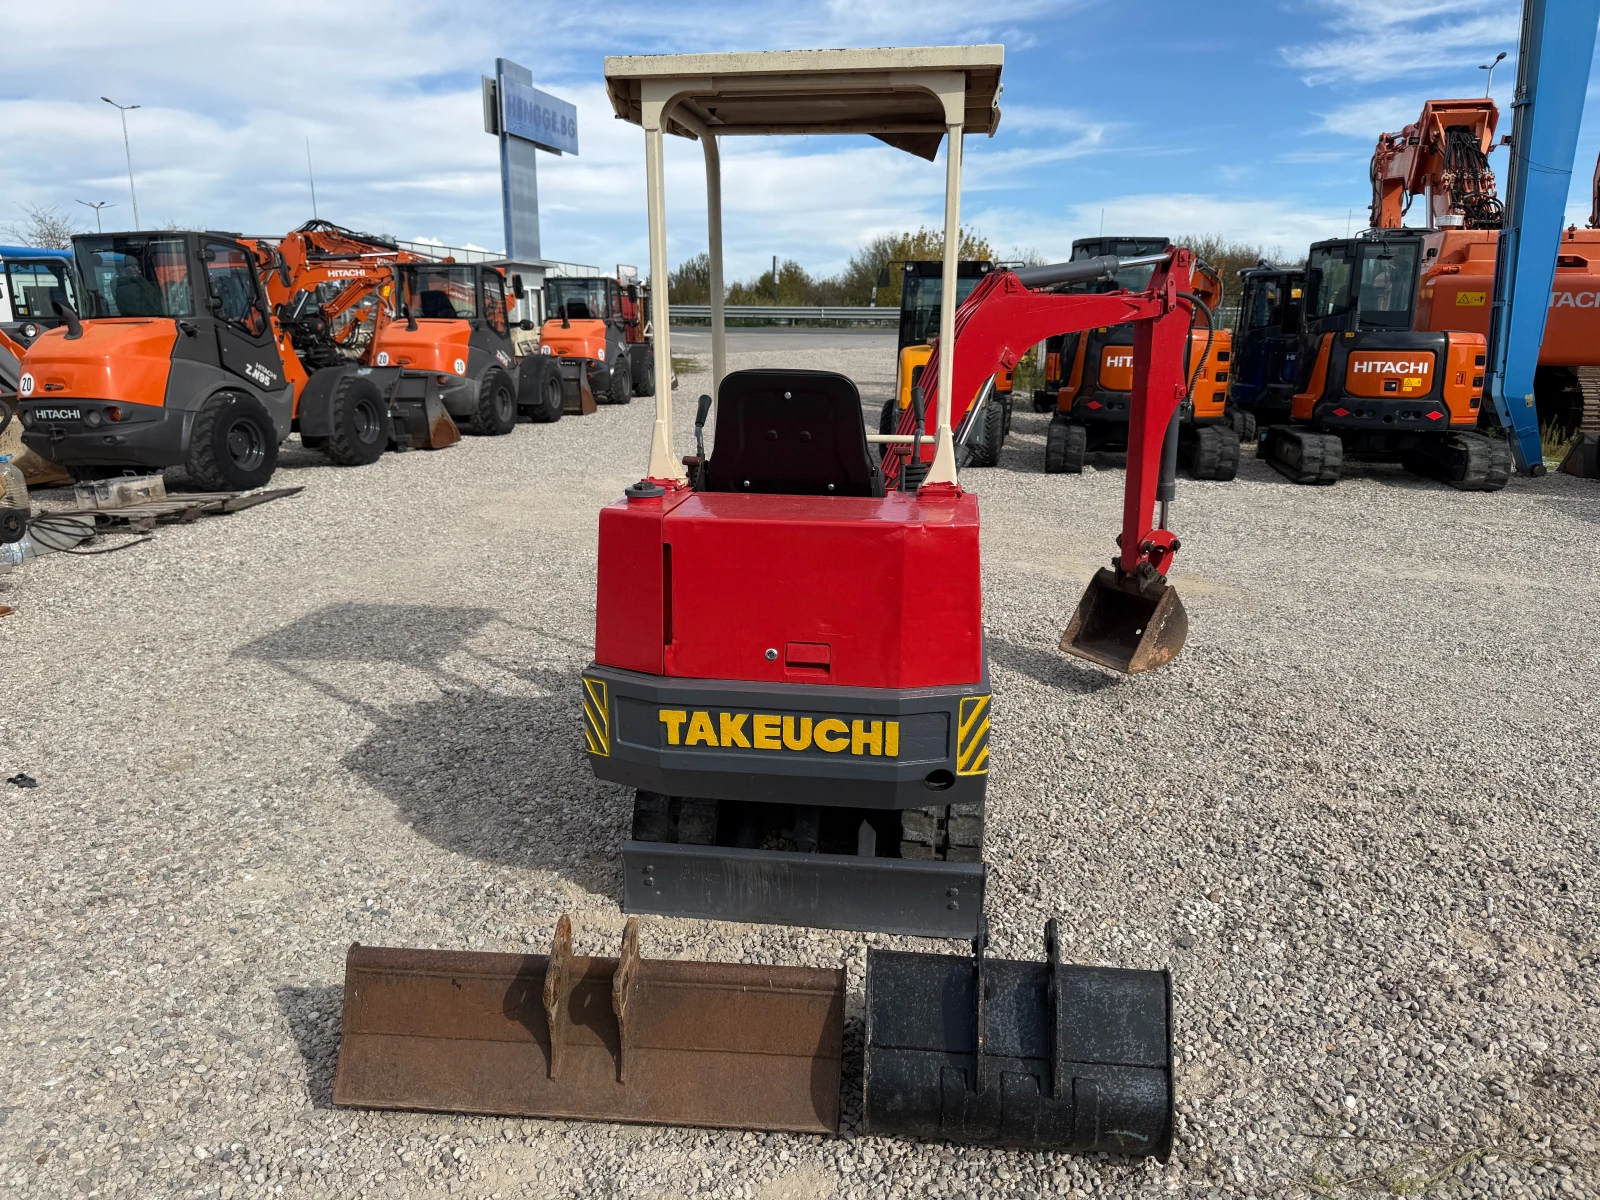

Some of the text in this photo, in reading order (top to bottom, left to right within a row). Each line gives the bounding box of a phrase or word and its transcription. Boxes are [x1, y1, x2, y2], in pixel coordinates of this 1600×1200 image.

[327, 269, 366, 278] HITACHI
[379, 354, 387, 364] 20
[255, 362, 277, 380] HITACHI
[1354, 361, 1428, 374] HITACHI
[22, 377, 32, 391] 20
[35, 409, 80, 419] HITACHI
[659, 709, 899, 757] TAKEUCHI
